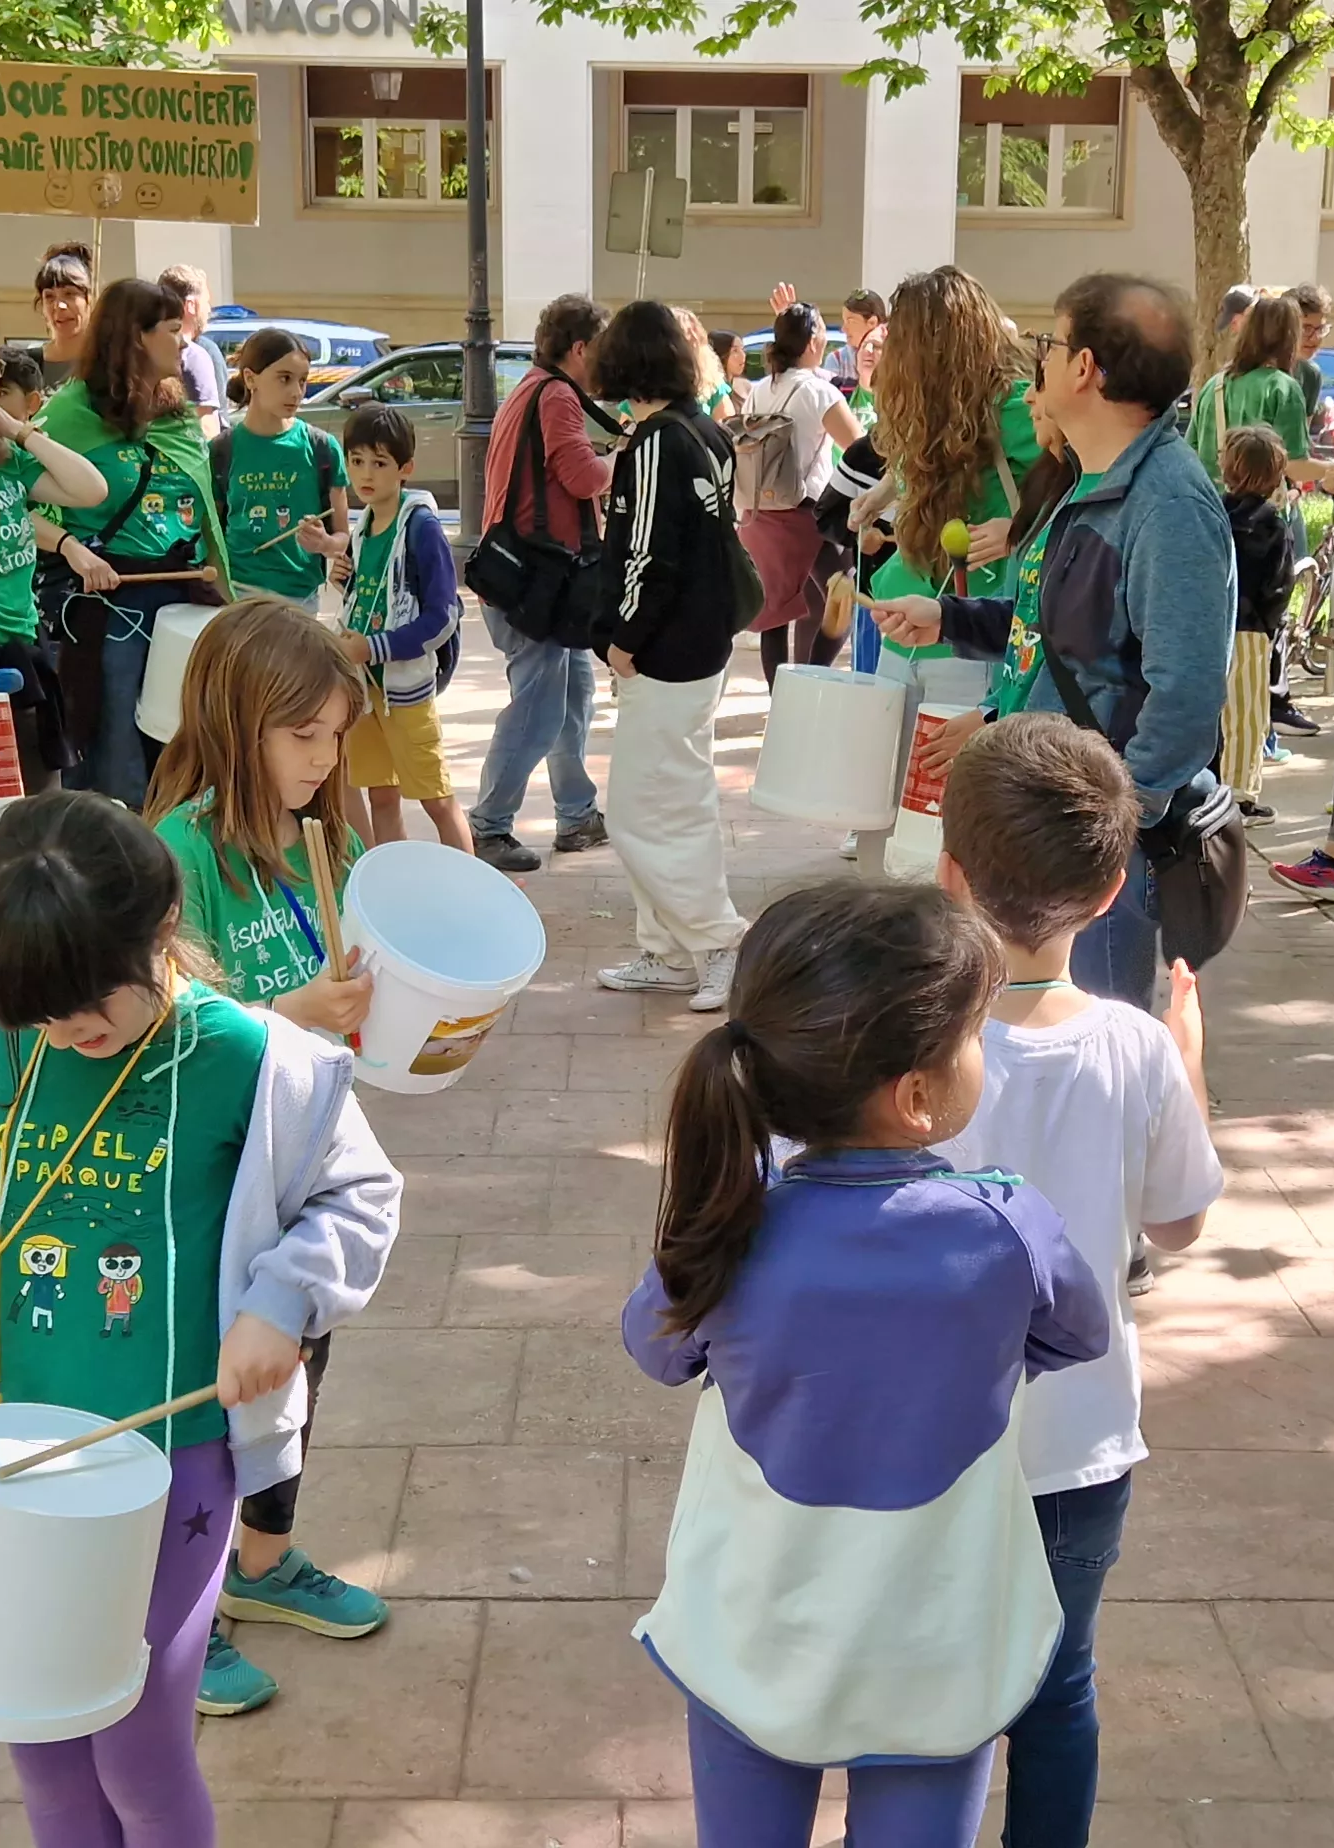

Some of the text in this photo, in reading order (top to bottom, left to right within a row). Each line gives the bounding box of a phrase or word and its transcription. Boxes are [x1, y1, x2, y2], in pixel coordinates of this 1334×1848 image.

[50, 131, 133, 173] VUESTRO
[255, 966, 289, 995] DE
[93, 1131, 136, 1161] EL
[17, 1160, 143, 1194] PARQUE
